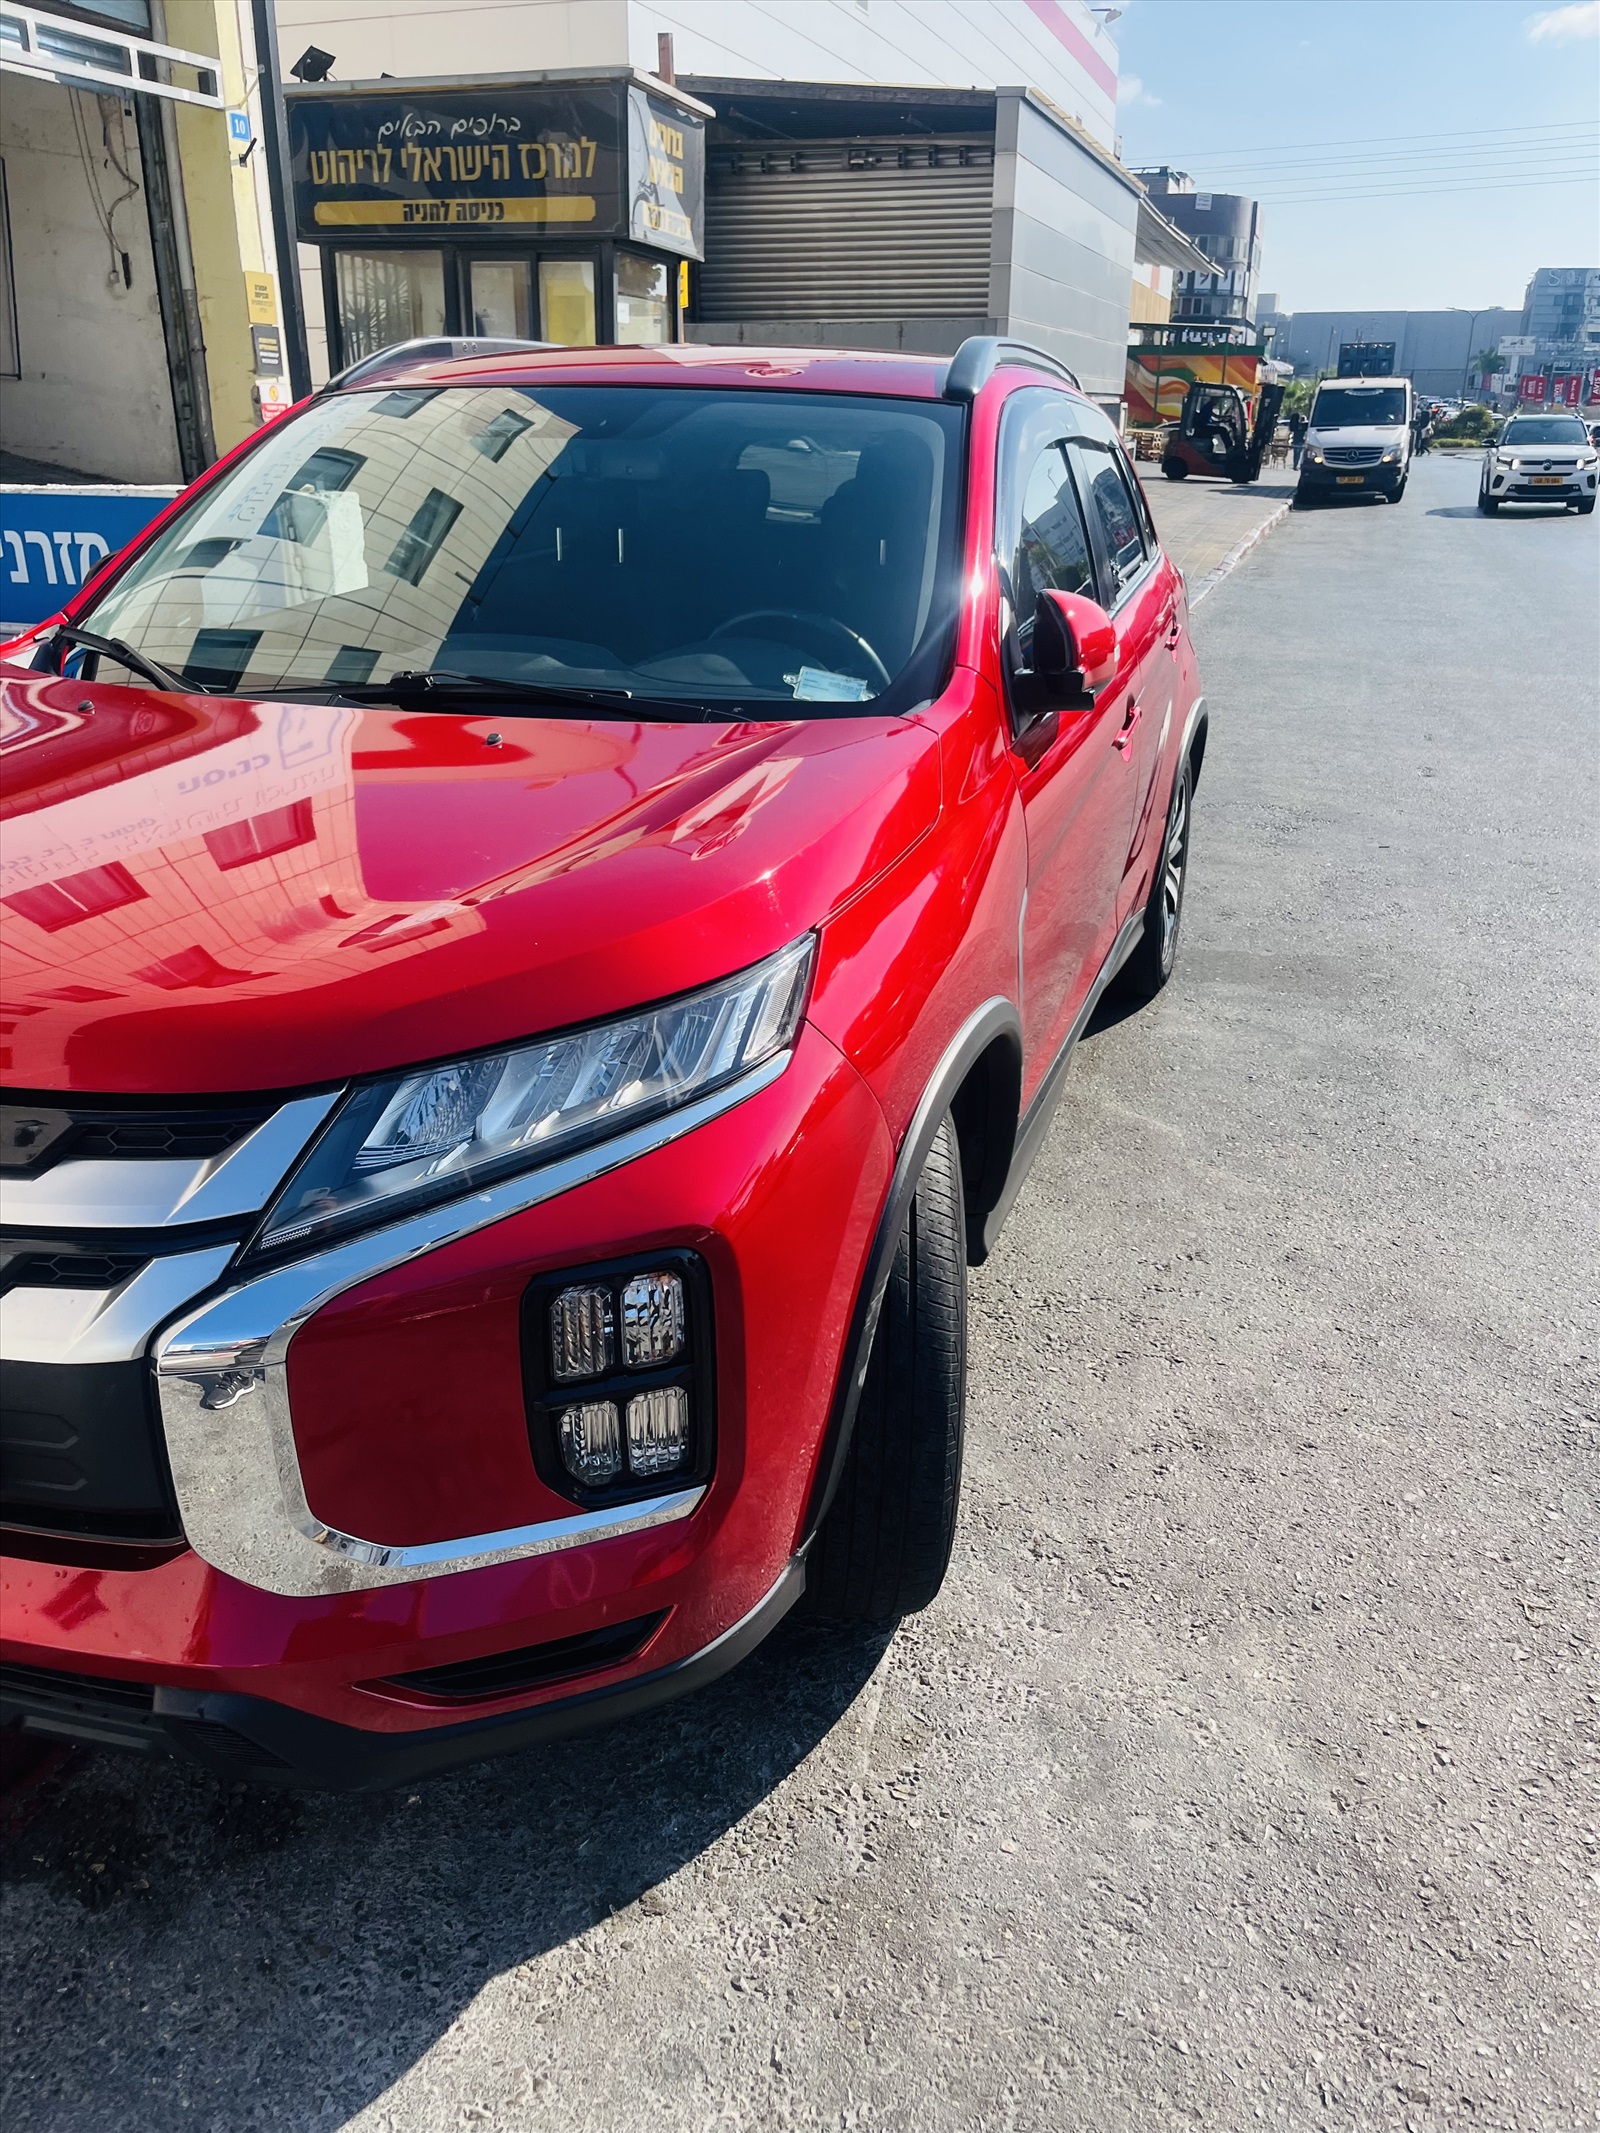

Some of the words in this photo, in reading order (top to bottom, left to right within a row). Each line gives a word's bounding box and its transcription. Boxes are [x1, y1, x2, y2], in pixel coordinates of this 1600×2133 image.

[234, 119, 246, 135] 10
[378, 112, 441, 142] הבאים
[451, 115, 521, 140] ברוכים
[310, 143, 392, 185] לריהוט
[401, 141, 510, 183] הישראלי
[518, 136, 597, 179] למרכז
[403, 200, 450, 223] לחניה
[456, 201, 504, 221] כניסה
